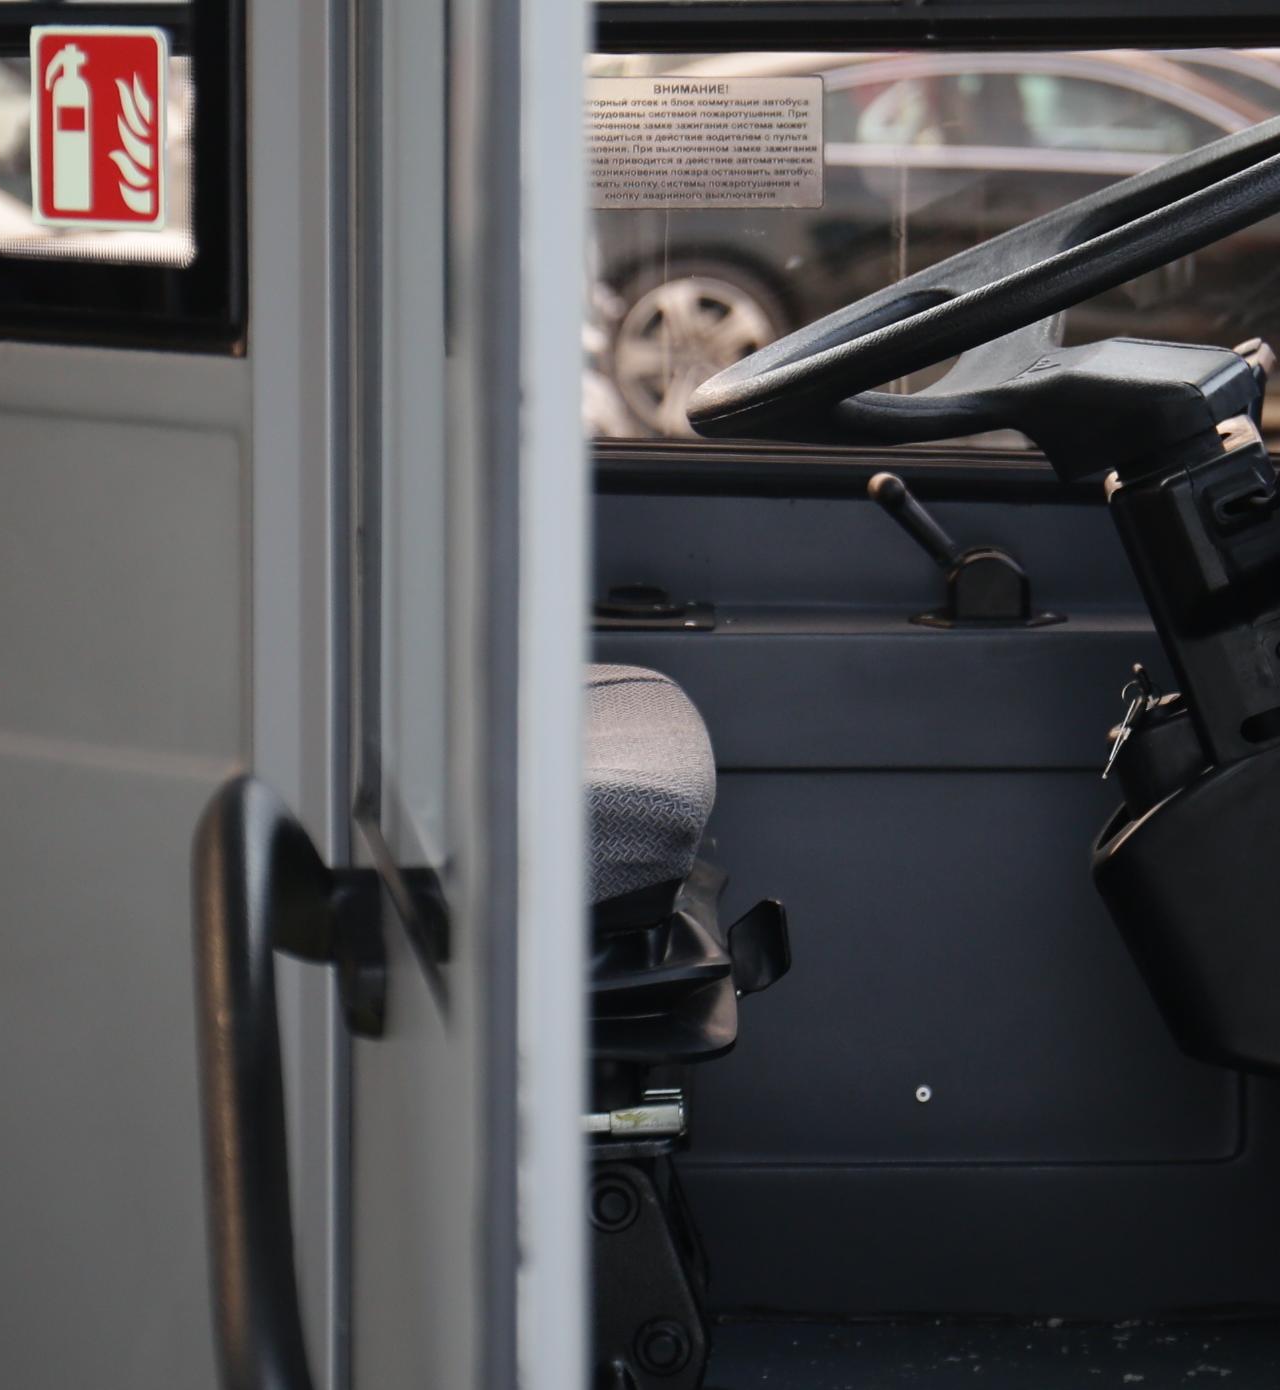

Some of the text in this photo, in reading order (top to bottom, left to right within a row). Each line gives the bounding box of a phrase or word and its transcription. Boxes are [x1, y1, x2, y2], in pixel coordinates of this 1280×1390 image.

[653, 84, 729, 95] ВНИМАНИЕ!
[592, 111, 646, 119] рудованы
[787, 109, 808, 118] При
[592, 134, 643, 142] водиться
[633, 144, 653, 154] При
